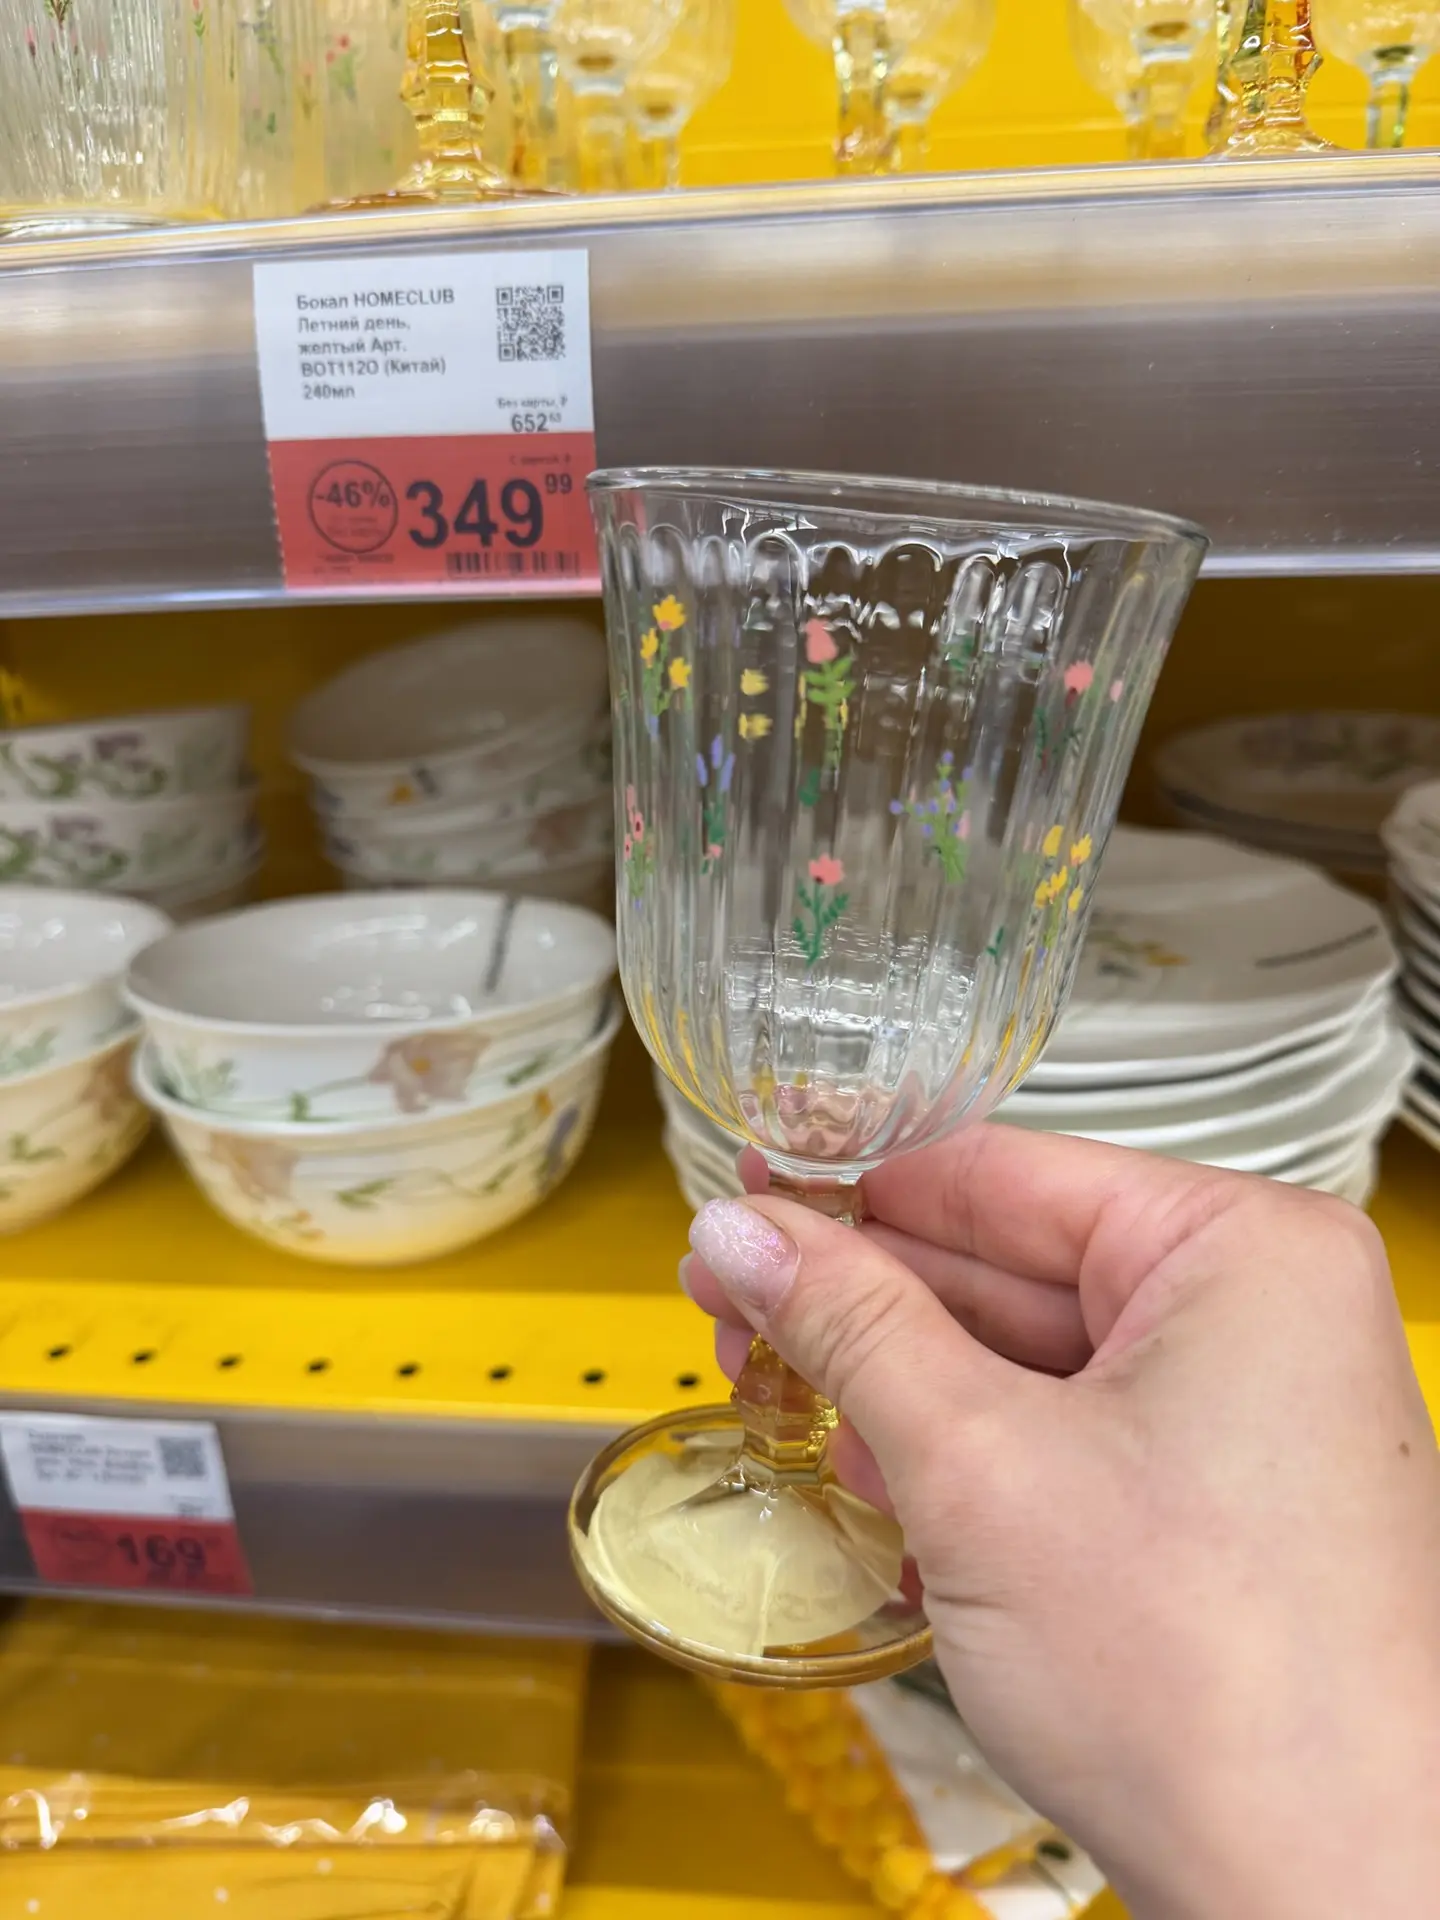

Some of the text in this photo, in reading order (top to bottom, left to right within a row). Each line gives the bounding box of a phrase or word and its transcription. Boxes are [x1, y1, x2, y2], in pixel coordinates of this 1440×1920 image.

[297, 288, 455, 310] Бокал HOMECLUB
[298, 317, 360, 333] Летний
[298, 337, 407, 355] желтый Арт.
[384, 356, 446, 377] (Китай)
[303, 384, 356, 400] 240мл
[511, 412, 549, 433] 652
[315, 480, 391, 509] -46%
[405, 478, 543, 549] 349
[545, 473, 572, 495] 99
